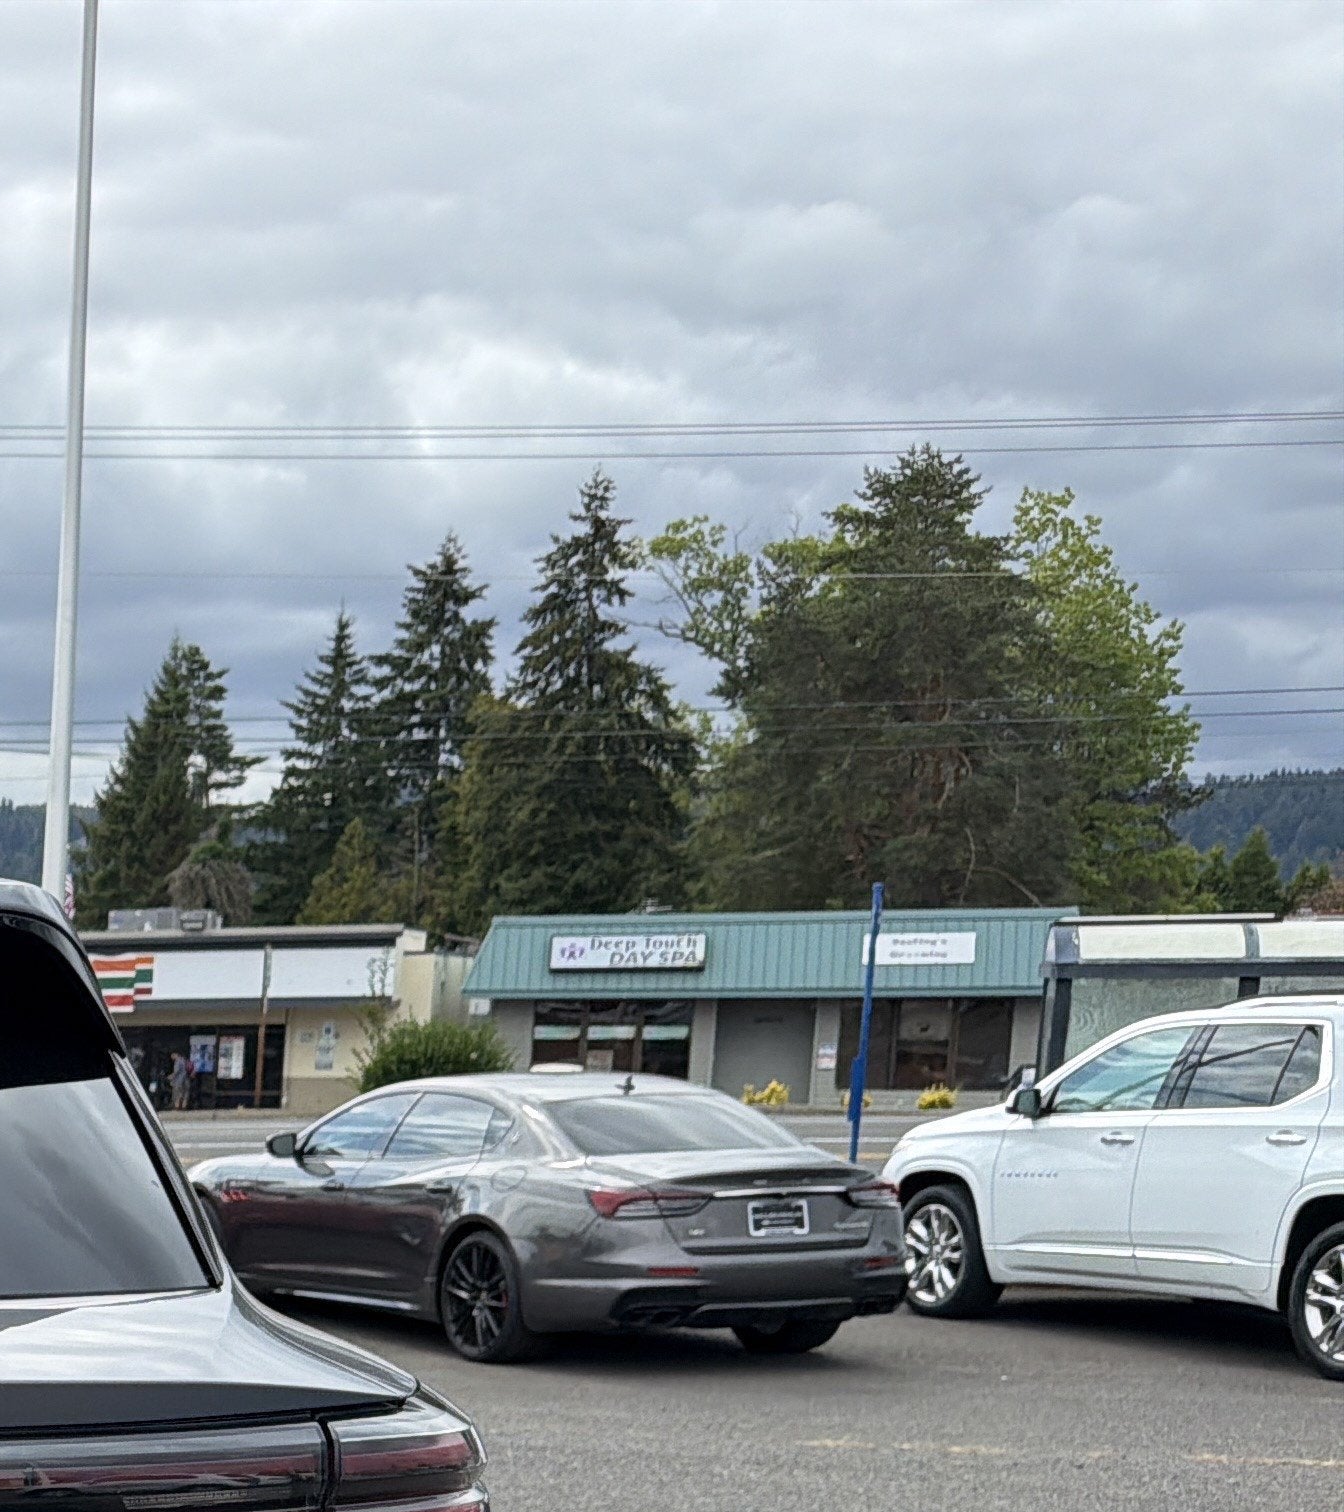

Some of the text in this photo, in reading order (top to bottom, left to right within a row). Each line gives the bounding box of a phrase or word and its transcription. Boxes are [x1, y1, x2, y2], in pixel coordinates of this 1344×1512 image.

[590, 935, 698, 953] Deep Touch
[609, 949, 697, 966] DAY SPA
